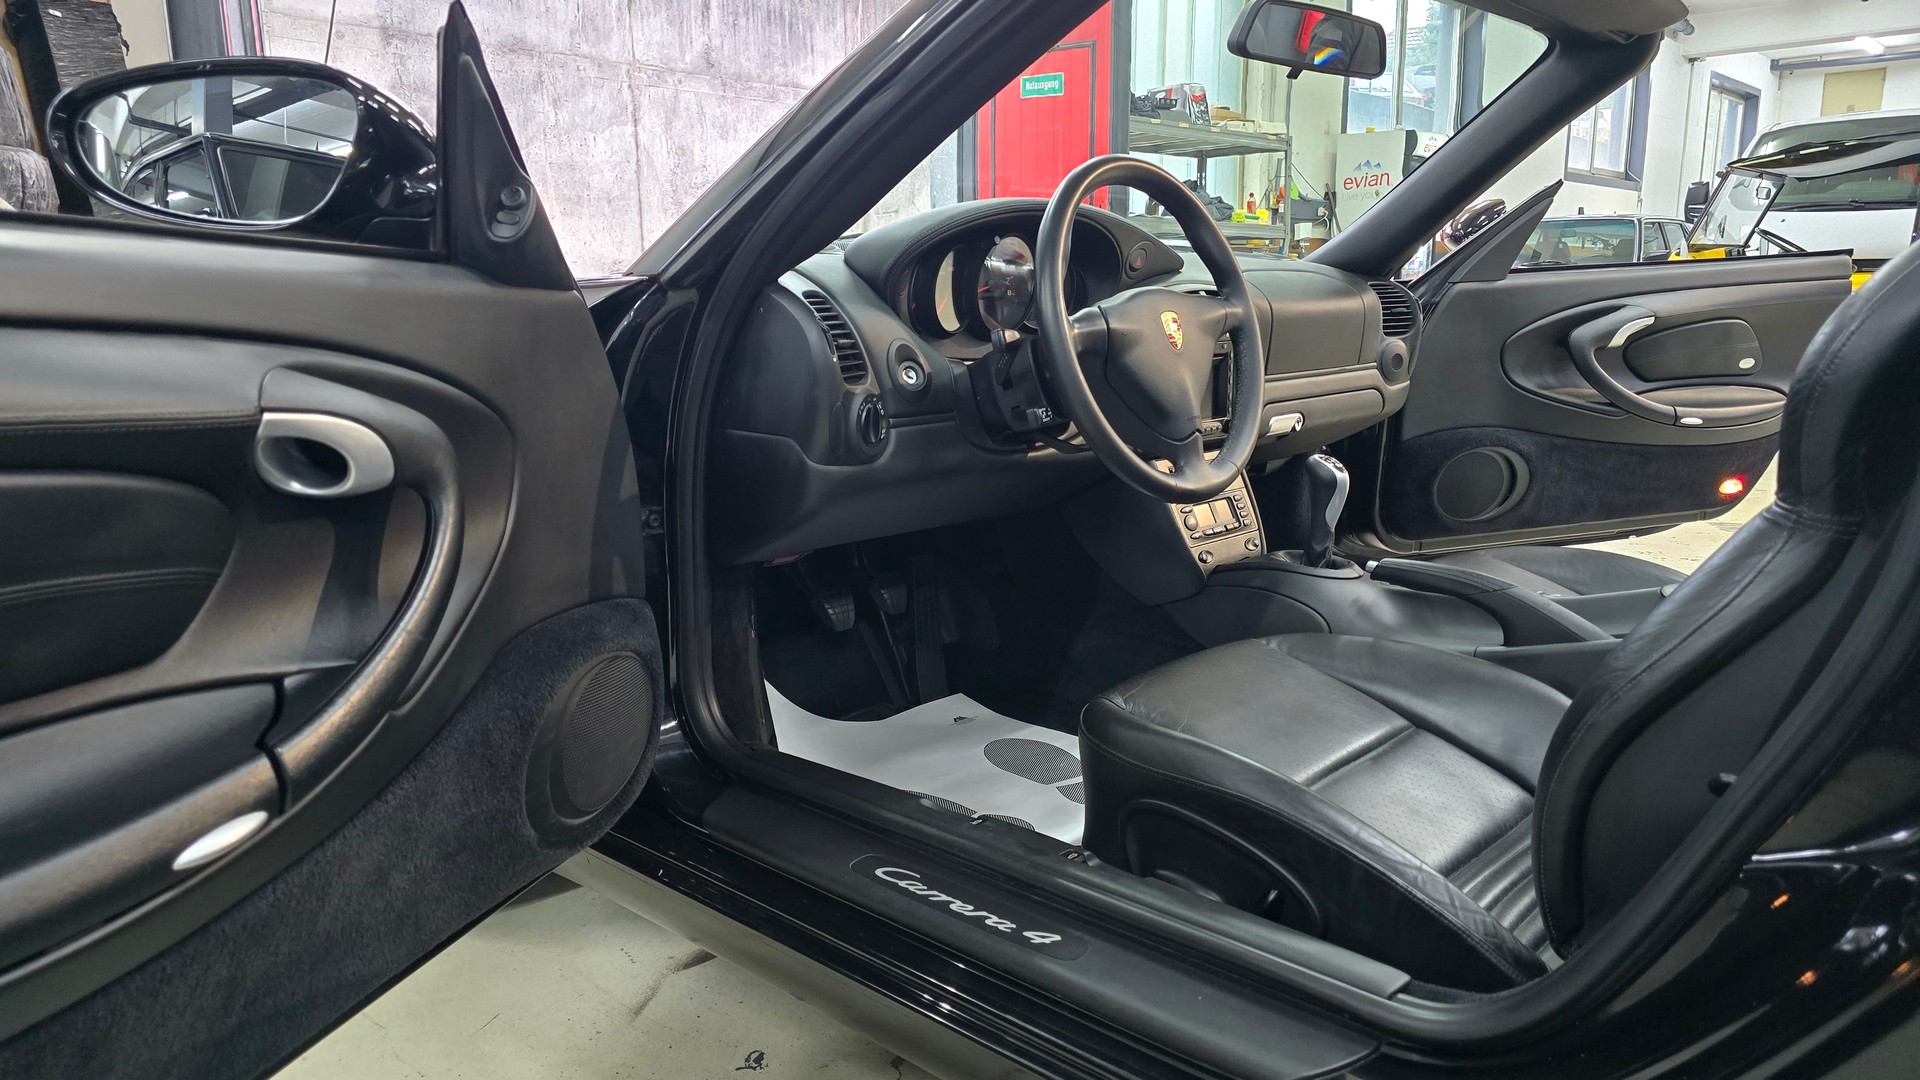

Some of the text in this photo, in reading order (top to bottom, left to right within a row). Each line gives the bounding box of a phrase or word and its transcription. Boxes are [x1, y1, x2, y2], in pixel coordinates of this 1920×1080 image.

[1343, 172, 1390, 191] evian
[874, 867, 1062, 944] Carrera 4
